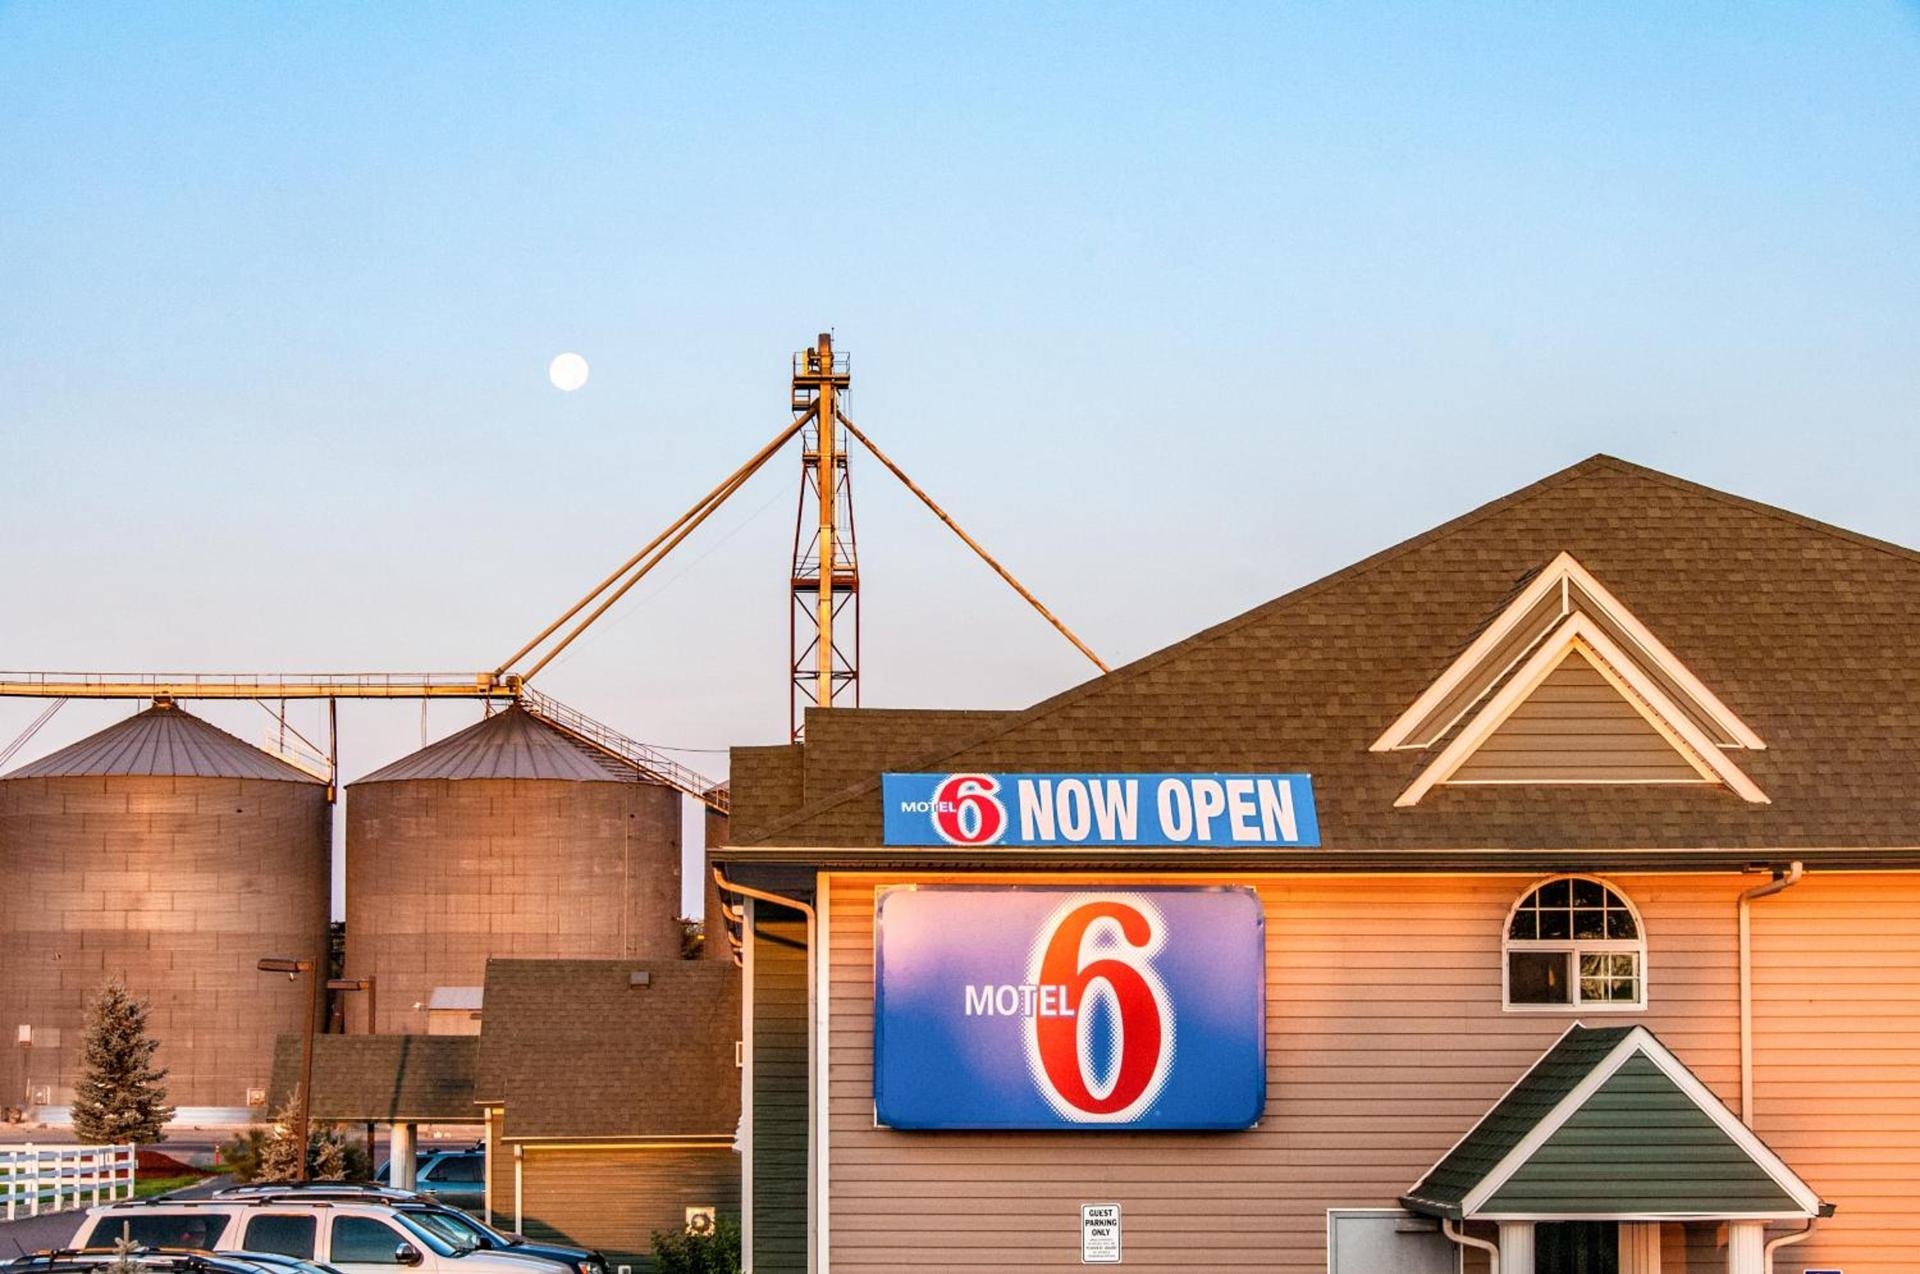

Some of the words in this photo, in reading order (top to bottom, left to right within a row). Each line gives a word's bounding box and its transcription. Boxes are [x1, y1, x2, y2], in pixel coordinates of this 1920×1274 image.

[901, 801, 956, 813] MOTEL
[938, 776, 1001, 843] 6
[1018, 779, 1138, 841] NOW
[1156, 778, 1298, 842] OPEN
[965, 984, 1075, 1017] MOTEL
[1036, 900, 1162, 1115] 6
[1088, 1209, 1112, 1217] GUEST
